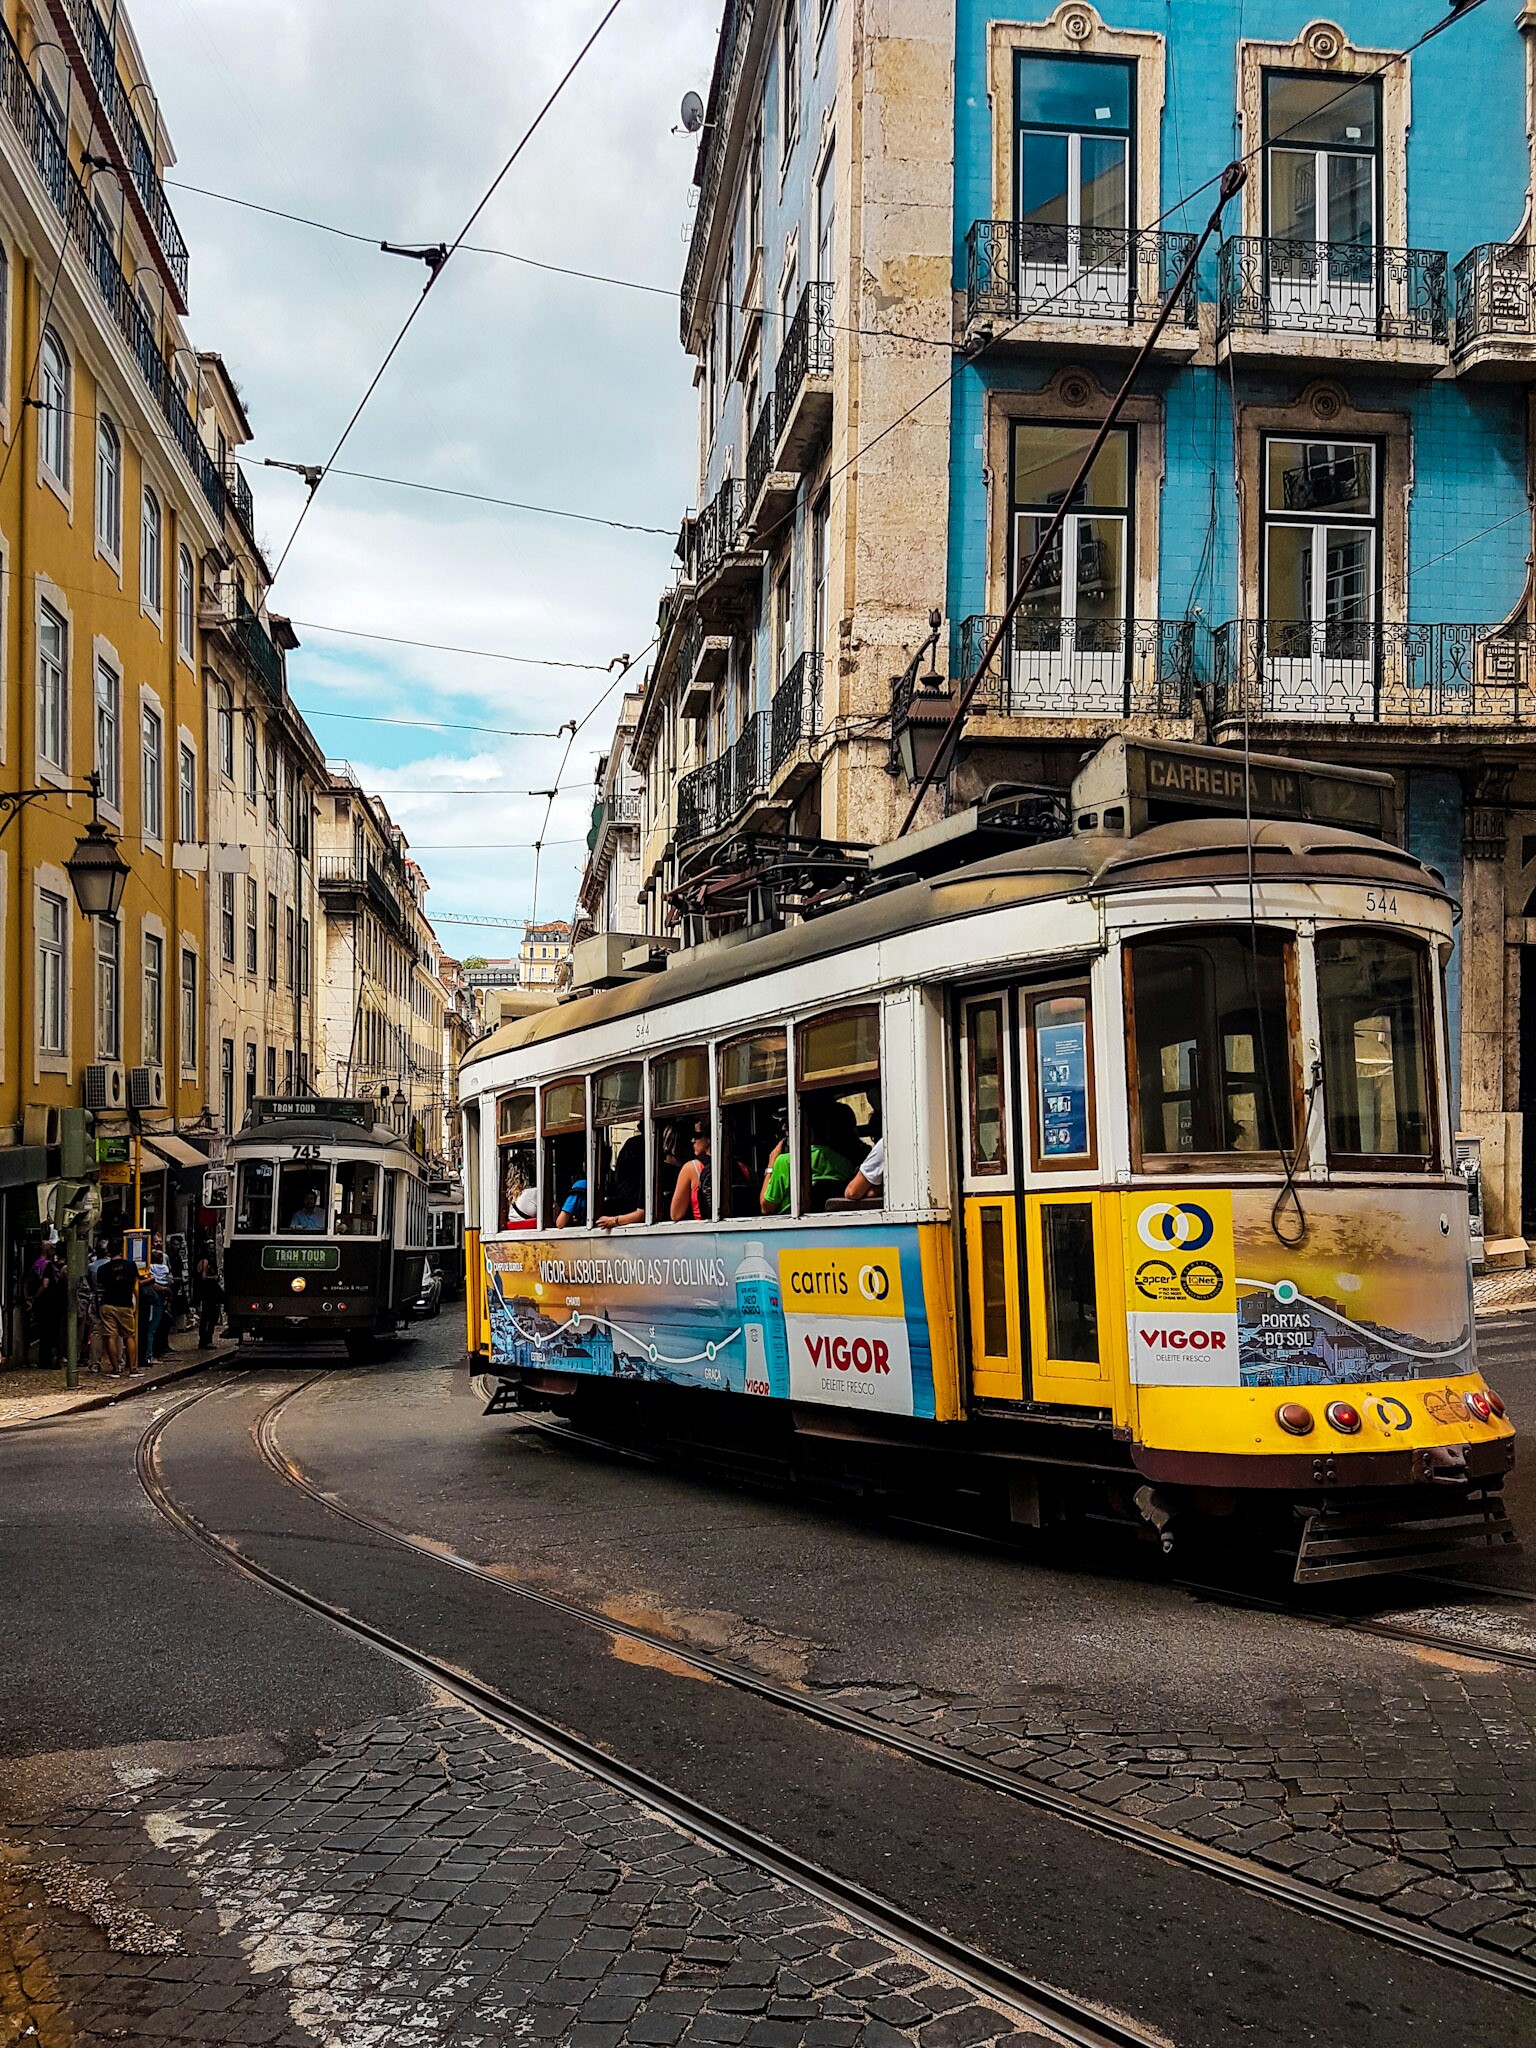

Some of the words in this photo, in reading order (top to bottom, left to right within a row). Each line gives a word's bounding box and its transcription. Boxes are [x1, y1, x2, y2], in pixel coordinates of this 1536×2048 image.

[1150, 760, 1259, 800] CARREIRA
[1366, 892, 1398, 915] 544
[635, 1024, 650, 1038] 544
[272, 1103, 294, 1114] TRAM
[295, 1103, 316, 1114] TOUR
[291, 1145, 321, 1159] 745
[275, 1249, 299, 1262] TRAM
[301, 1249, 326, 1262] TOUR
[539, 1259, 569, 1284] VIGOR.
[568, 1259, 615, 1284] LISBOETA
[614, 1258, 645, 1285] COMO
[648, 1258, 661, 1285] AS
[662, 1259, 670, 1285] 7
[672, 1258, 729, 1287] COLINAS.
[791, 1262, 849, 1295] carris
[1142, 1276, 1171, 1286] apcer
[1188, 1276, 1215, 1285] IQNet
[1261, 1313, 1311, 1328] PORTAS
[1139, 1329, 1227, 1350] VIGOR
[1265, 1331, 1284, 1346] DO
[1286, 1331, 1312, 1346] SOL
[803, 1333, 891, 1376] VIGOR
[1155, 1354, 1181, 1362] DELEITE
[1182, 1354, 1211, 1363] FRESCO
[704, 1368, 722, 1383] GRAÇA
[745, 1379, 770, 1396] VIGOR
[821, 1378, 845, 1392] DELEITE
[846, 1379, 876, 1396] FRESCO
